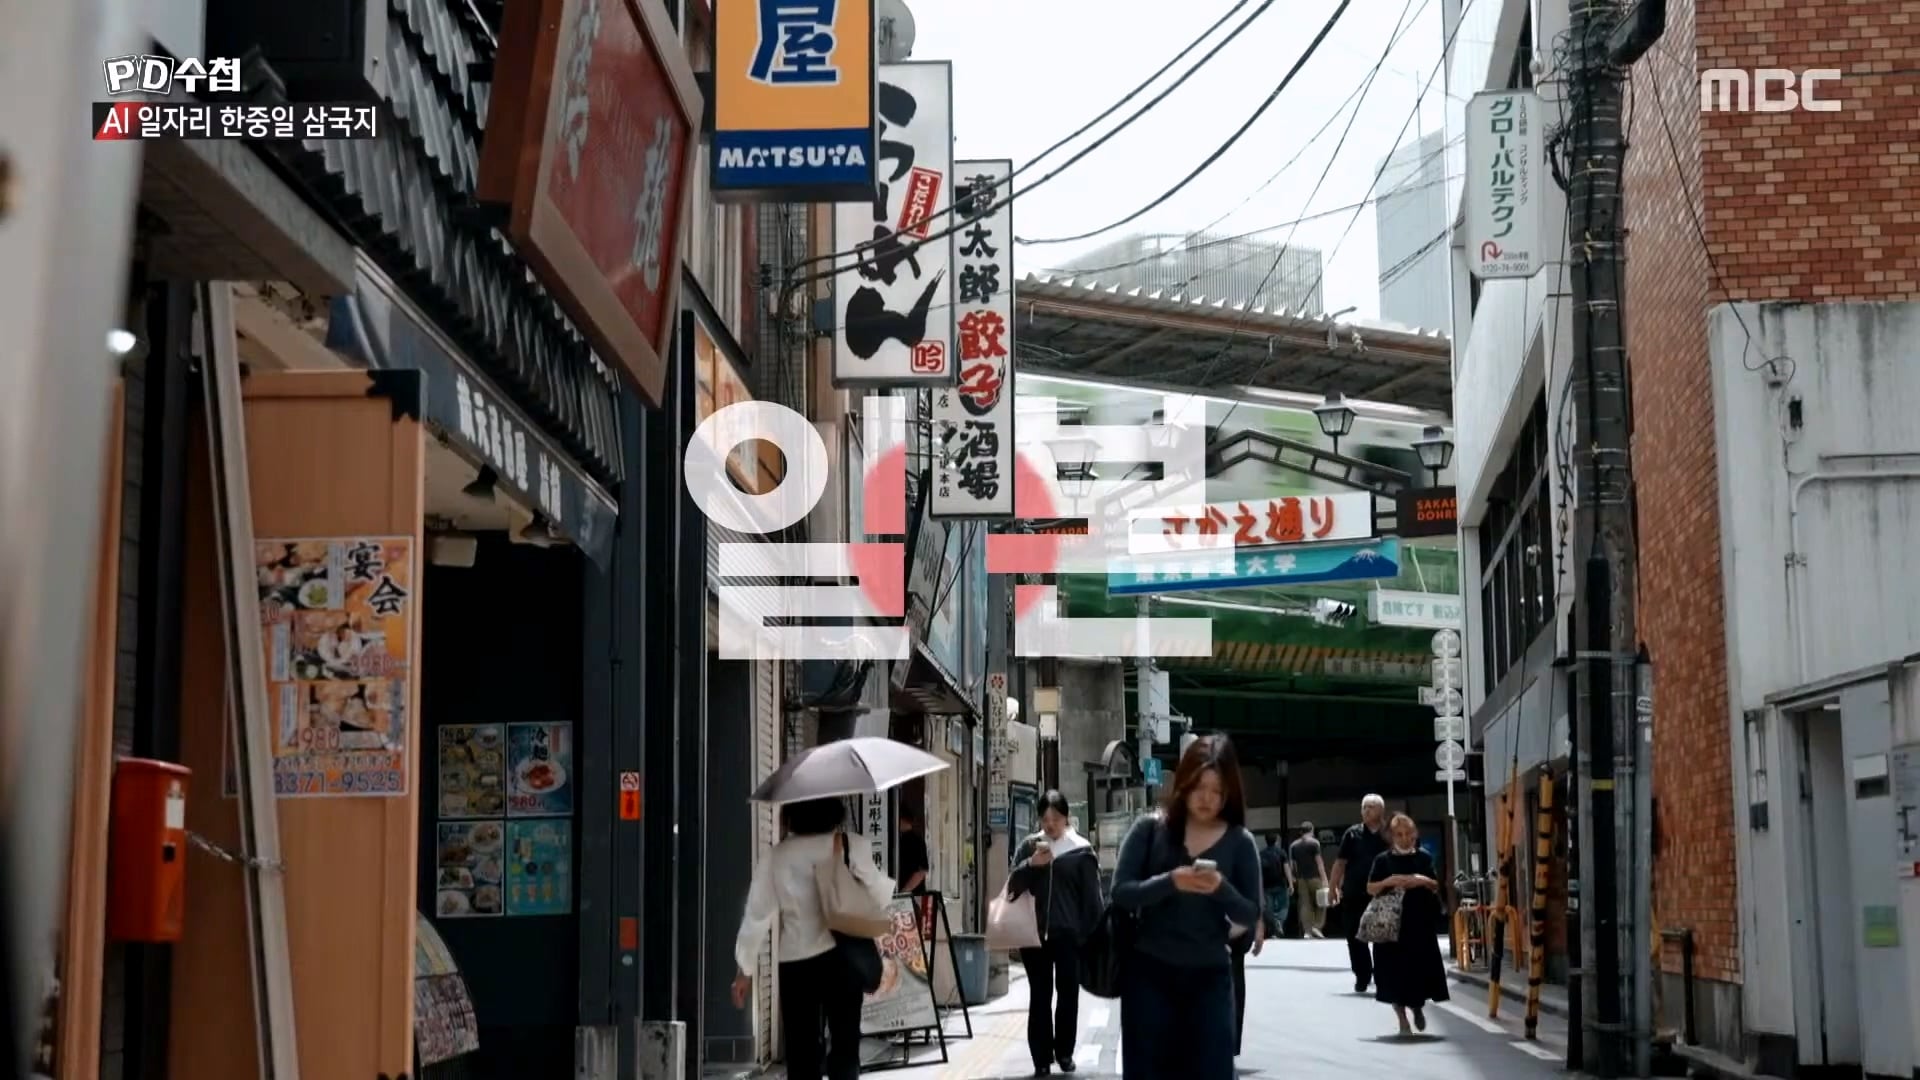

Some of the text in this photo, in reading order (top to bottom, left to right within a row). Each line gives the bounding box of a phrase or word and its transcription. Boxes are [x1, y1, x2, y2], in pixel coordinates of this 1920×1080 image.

[746, 0, 840, 86] 屋
[718, 144, 867, 168] MATSUYA
[1489, 96, 1515, 238] グローバルテクノ
[913, 344, 943, 372] 吟
[1160, 495, 1336, 548] さかえ通り
[344, 541, 408, 616] 宴会
